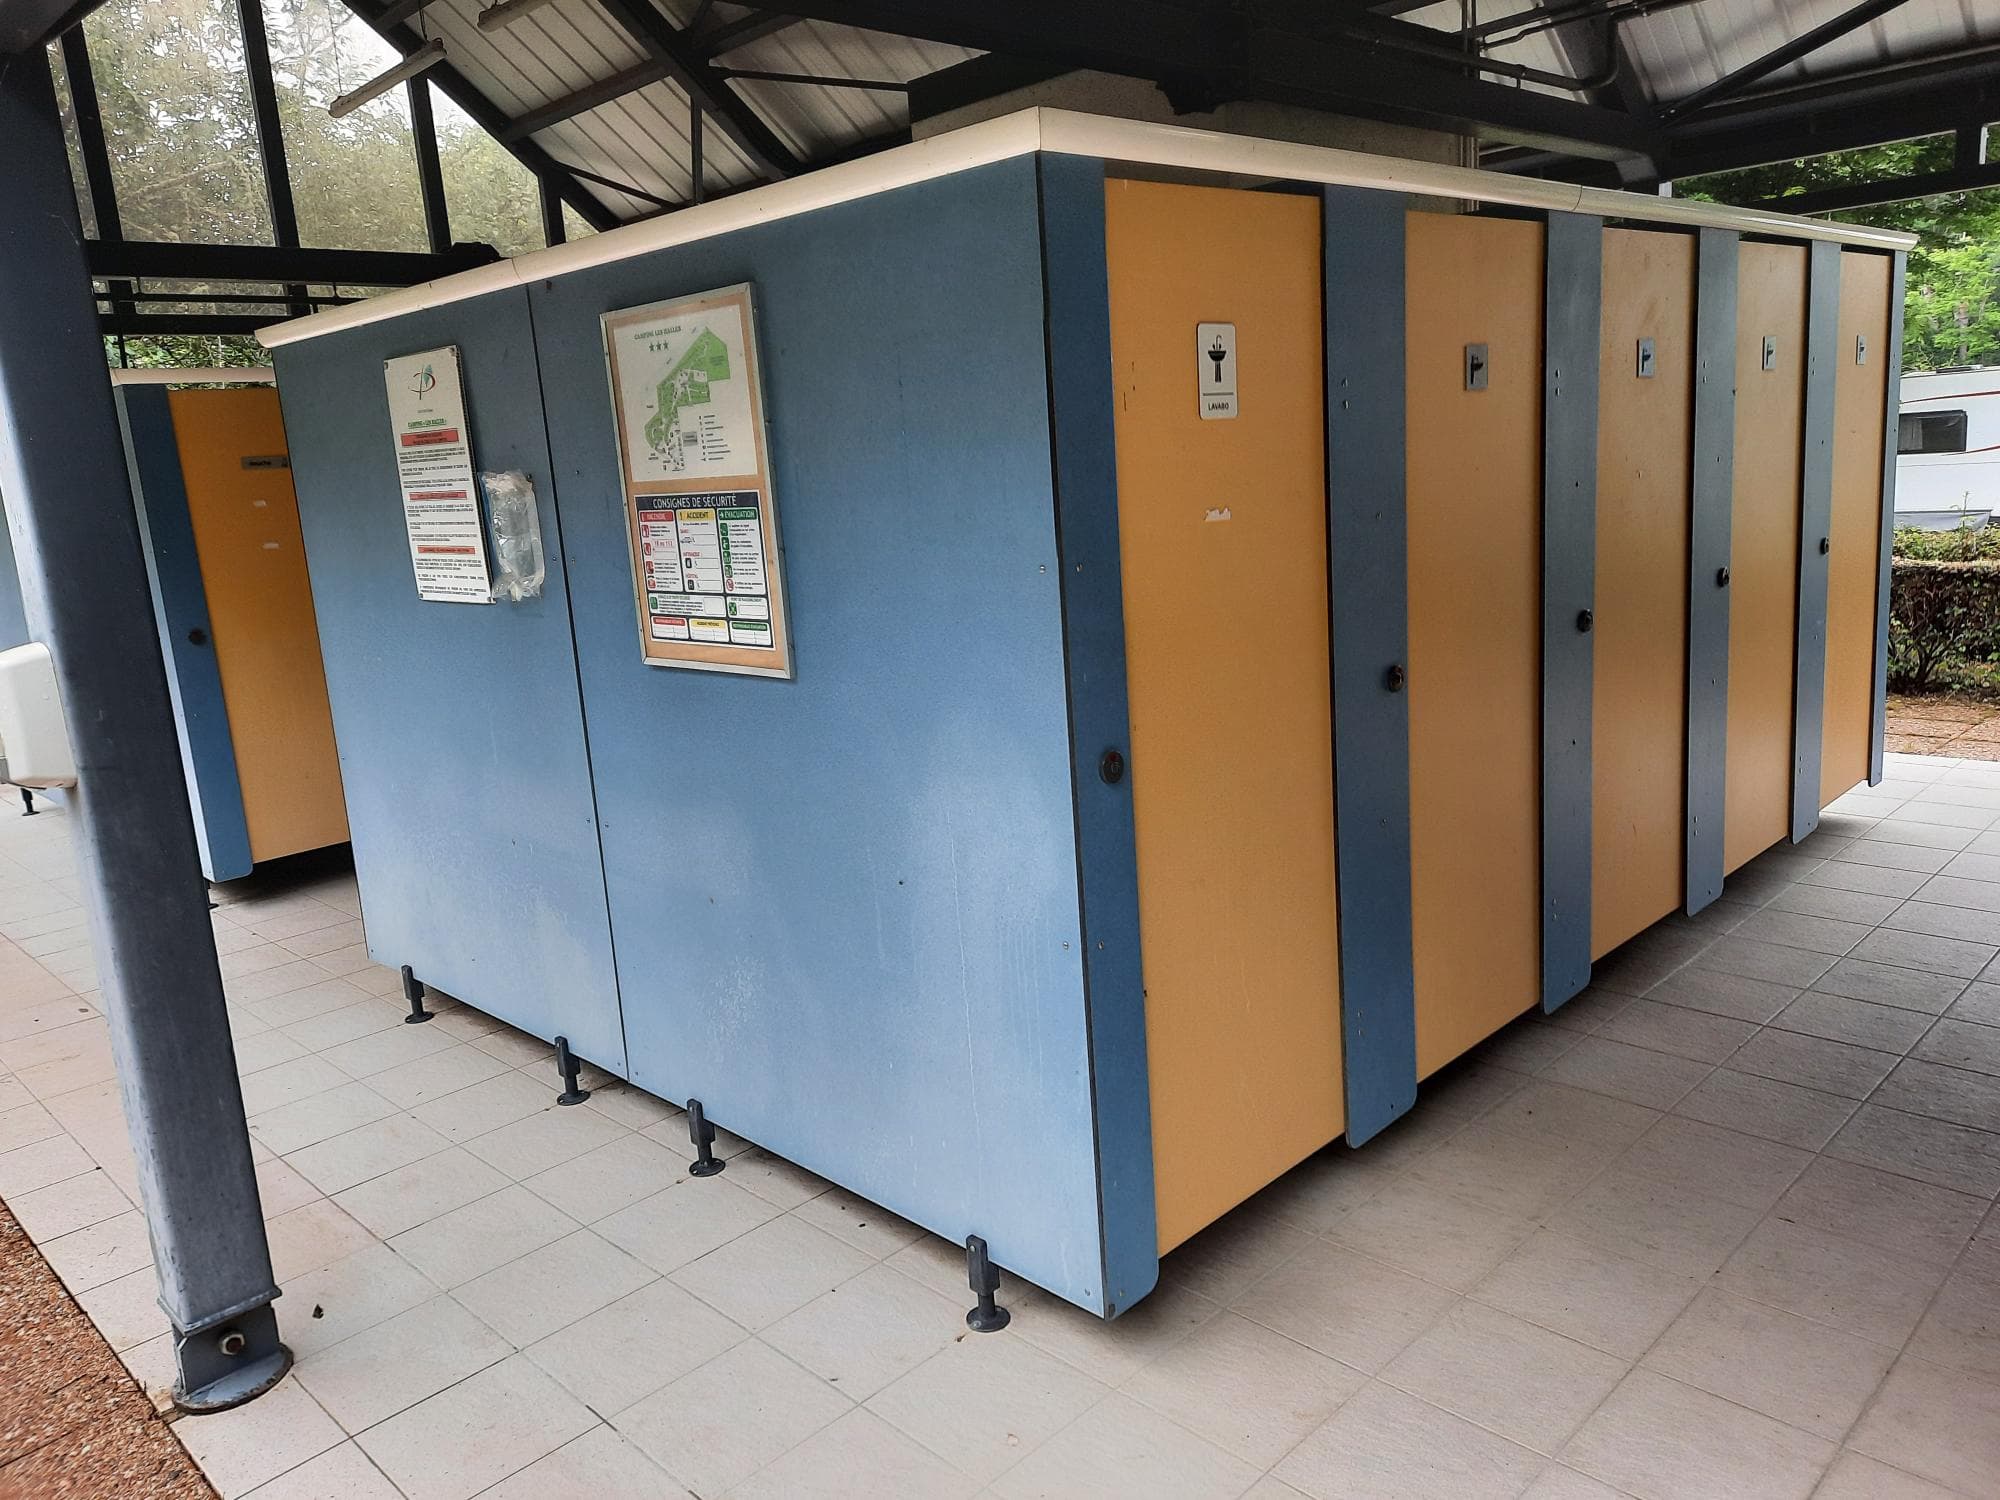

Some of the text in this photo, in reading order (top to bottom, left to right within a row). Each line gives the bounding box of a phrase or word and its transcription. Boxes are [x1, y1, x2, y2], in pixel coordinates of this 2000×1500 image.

[1208, 402, 1230, 411] LAVABO
[653, 493, 737, 509] CONSIGNES DE SÉCURITÉ
